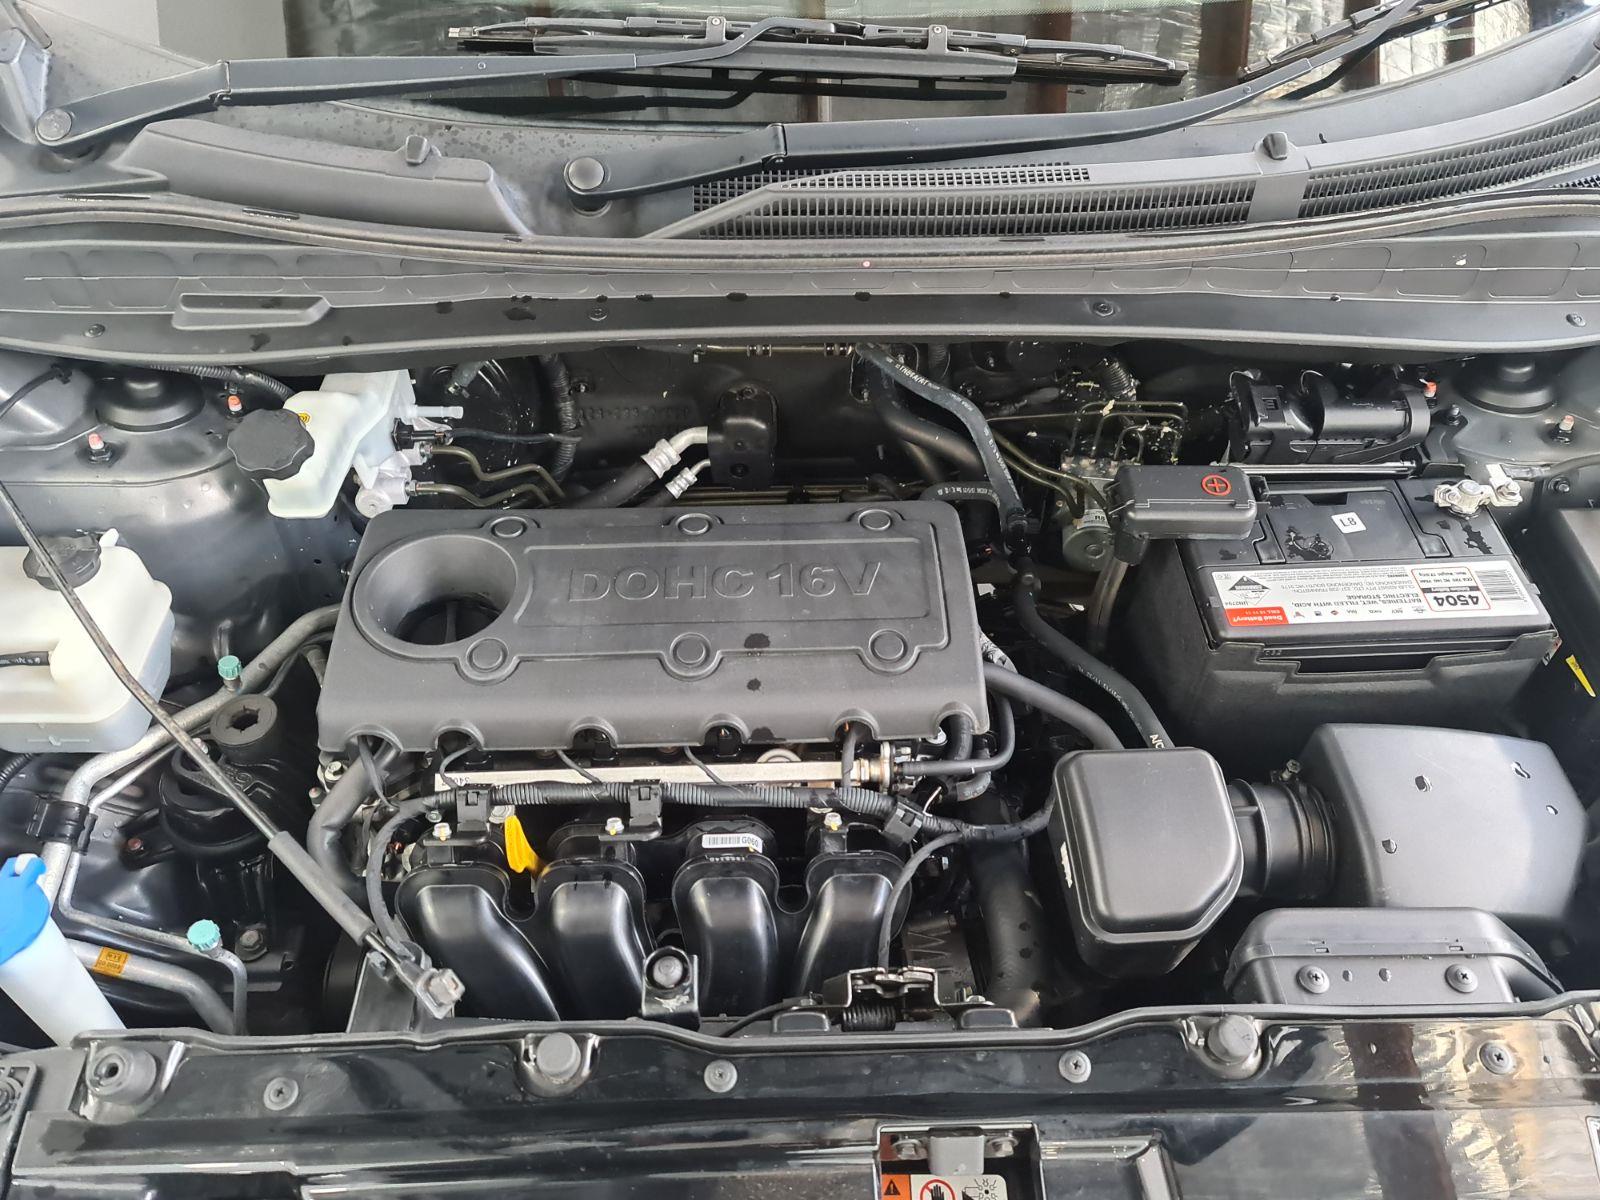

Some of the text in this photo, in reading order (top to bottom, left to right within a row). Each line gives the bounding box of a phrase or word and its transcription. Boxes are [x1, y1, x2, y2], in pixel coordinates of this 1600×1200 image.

[1339, 517, 1357, 527] L8
[568, 560, 882, 602] DOHC 16V
[1433, 594, 1479, 606] 4504
